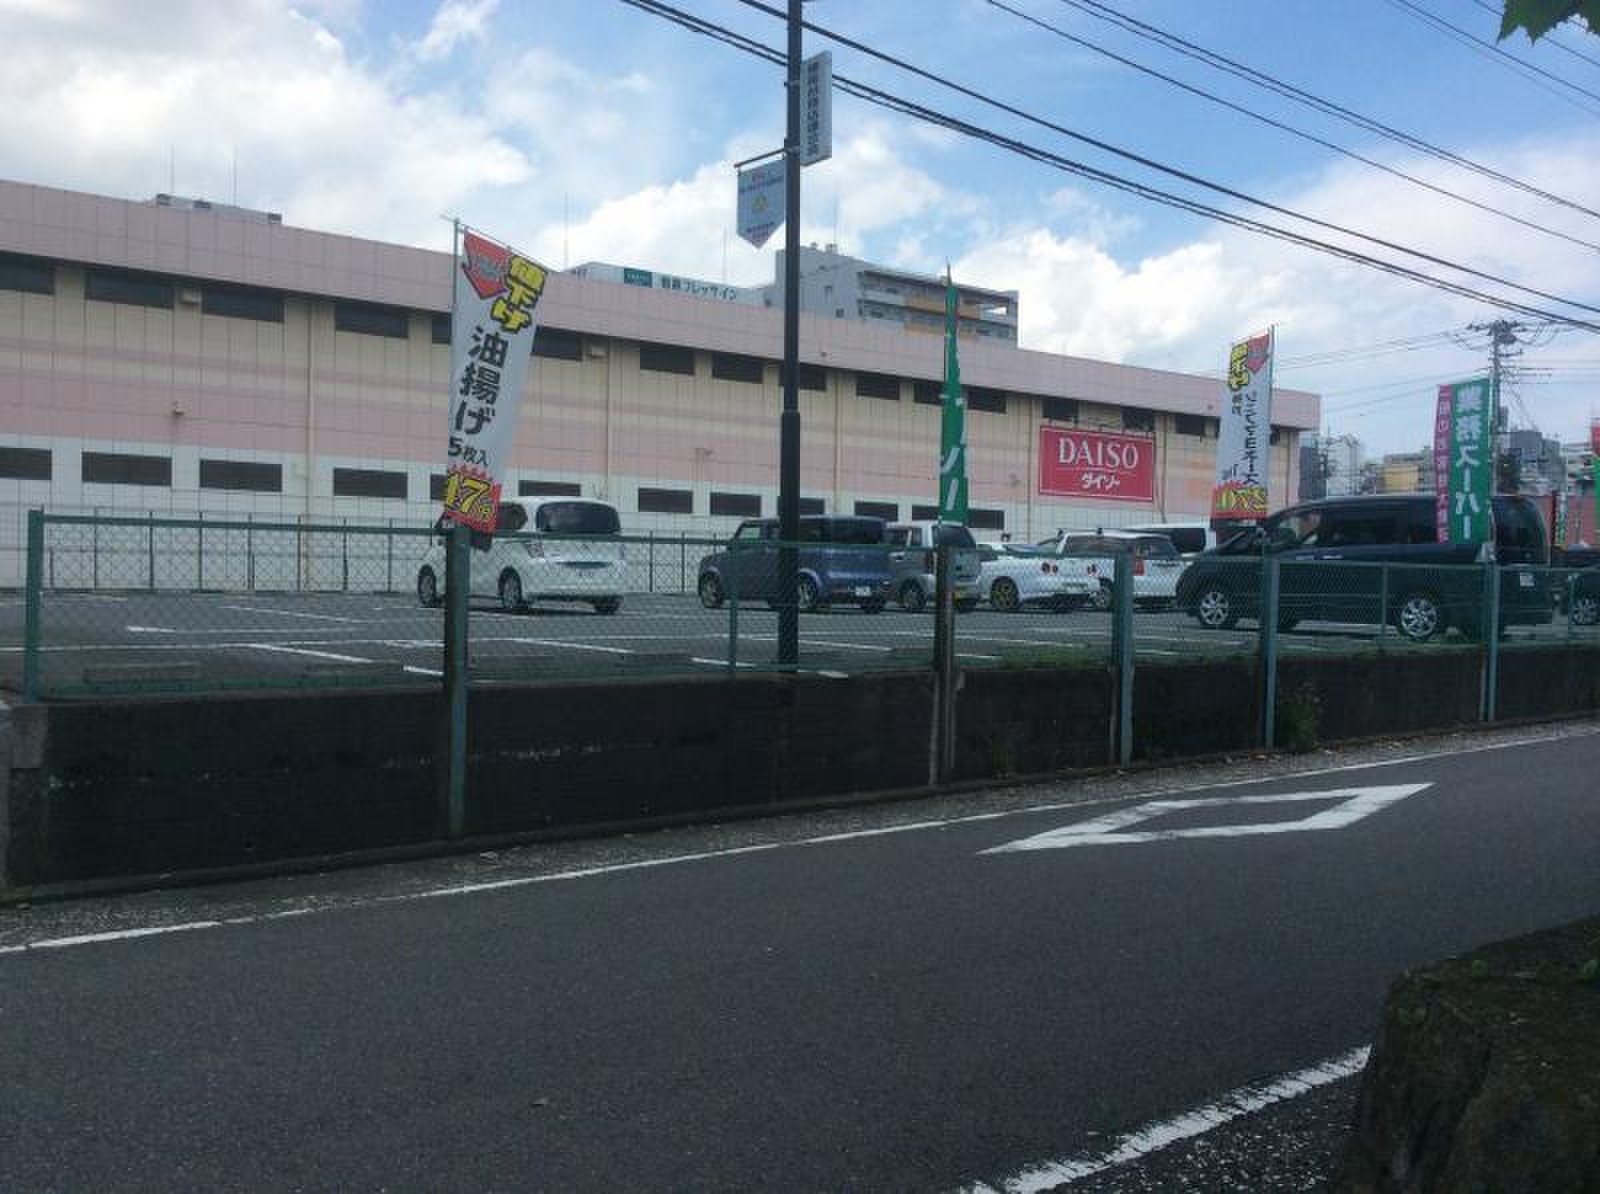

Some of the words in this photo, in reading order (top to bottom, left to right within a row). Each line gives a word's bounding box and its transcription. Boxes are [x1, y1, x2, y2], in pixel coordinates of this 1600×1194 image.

[454, 326, 508, 436] 油揚げ
[447, 437, 490, 468] 5枚入
[1058, 436, 1139, 470] DAISO
[1081, 471, 1121, 491] ダイソー
